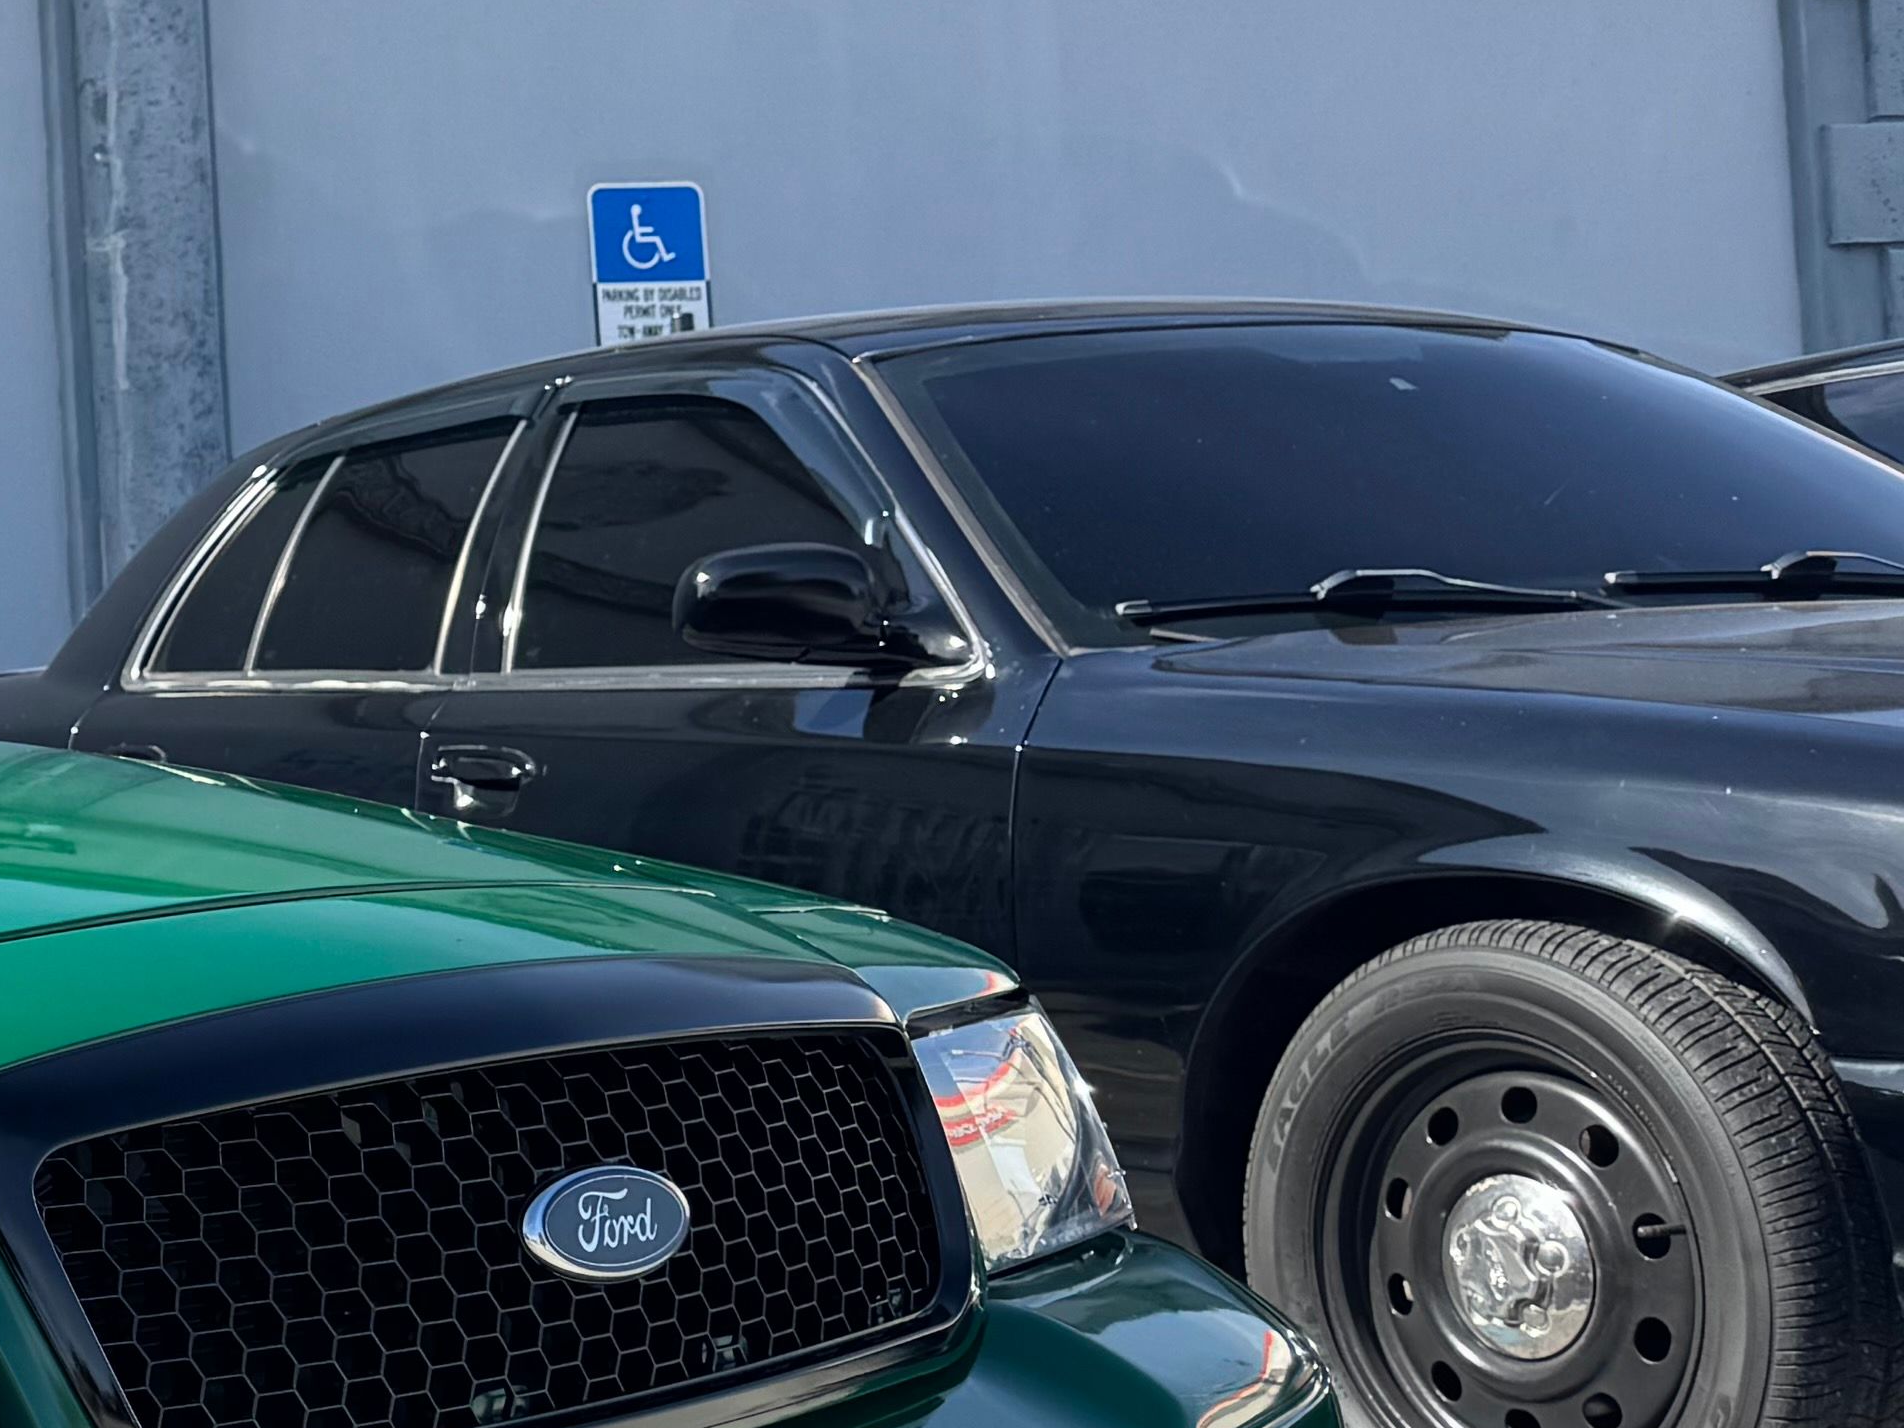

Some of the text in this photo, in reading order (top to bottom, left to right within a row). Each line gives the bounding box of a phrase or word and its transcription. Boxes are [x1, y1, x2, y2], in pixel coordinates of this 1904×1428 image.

[602, 286, 702, 302] PARKING BY DISABLED
[623, 304, 656, 319] PERMIT
[577, 1188, 658, 1252] Ford
